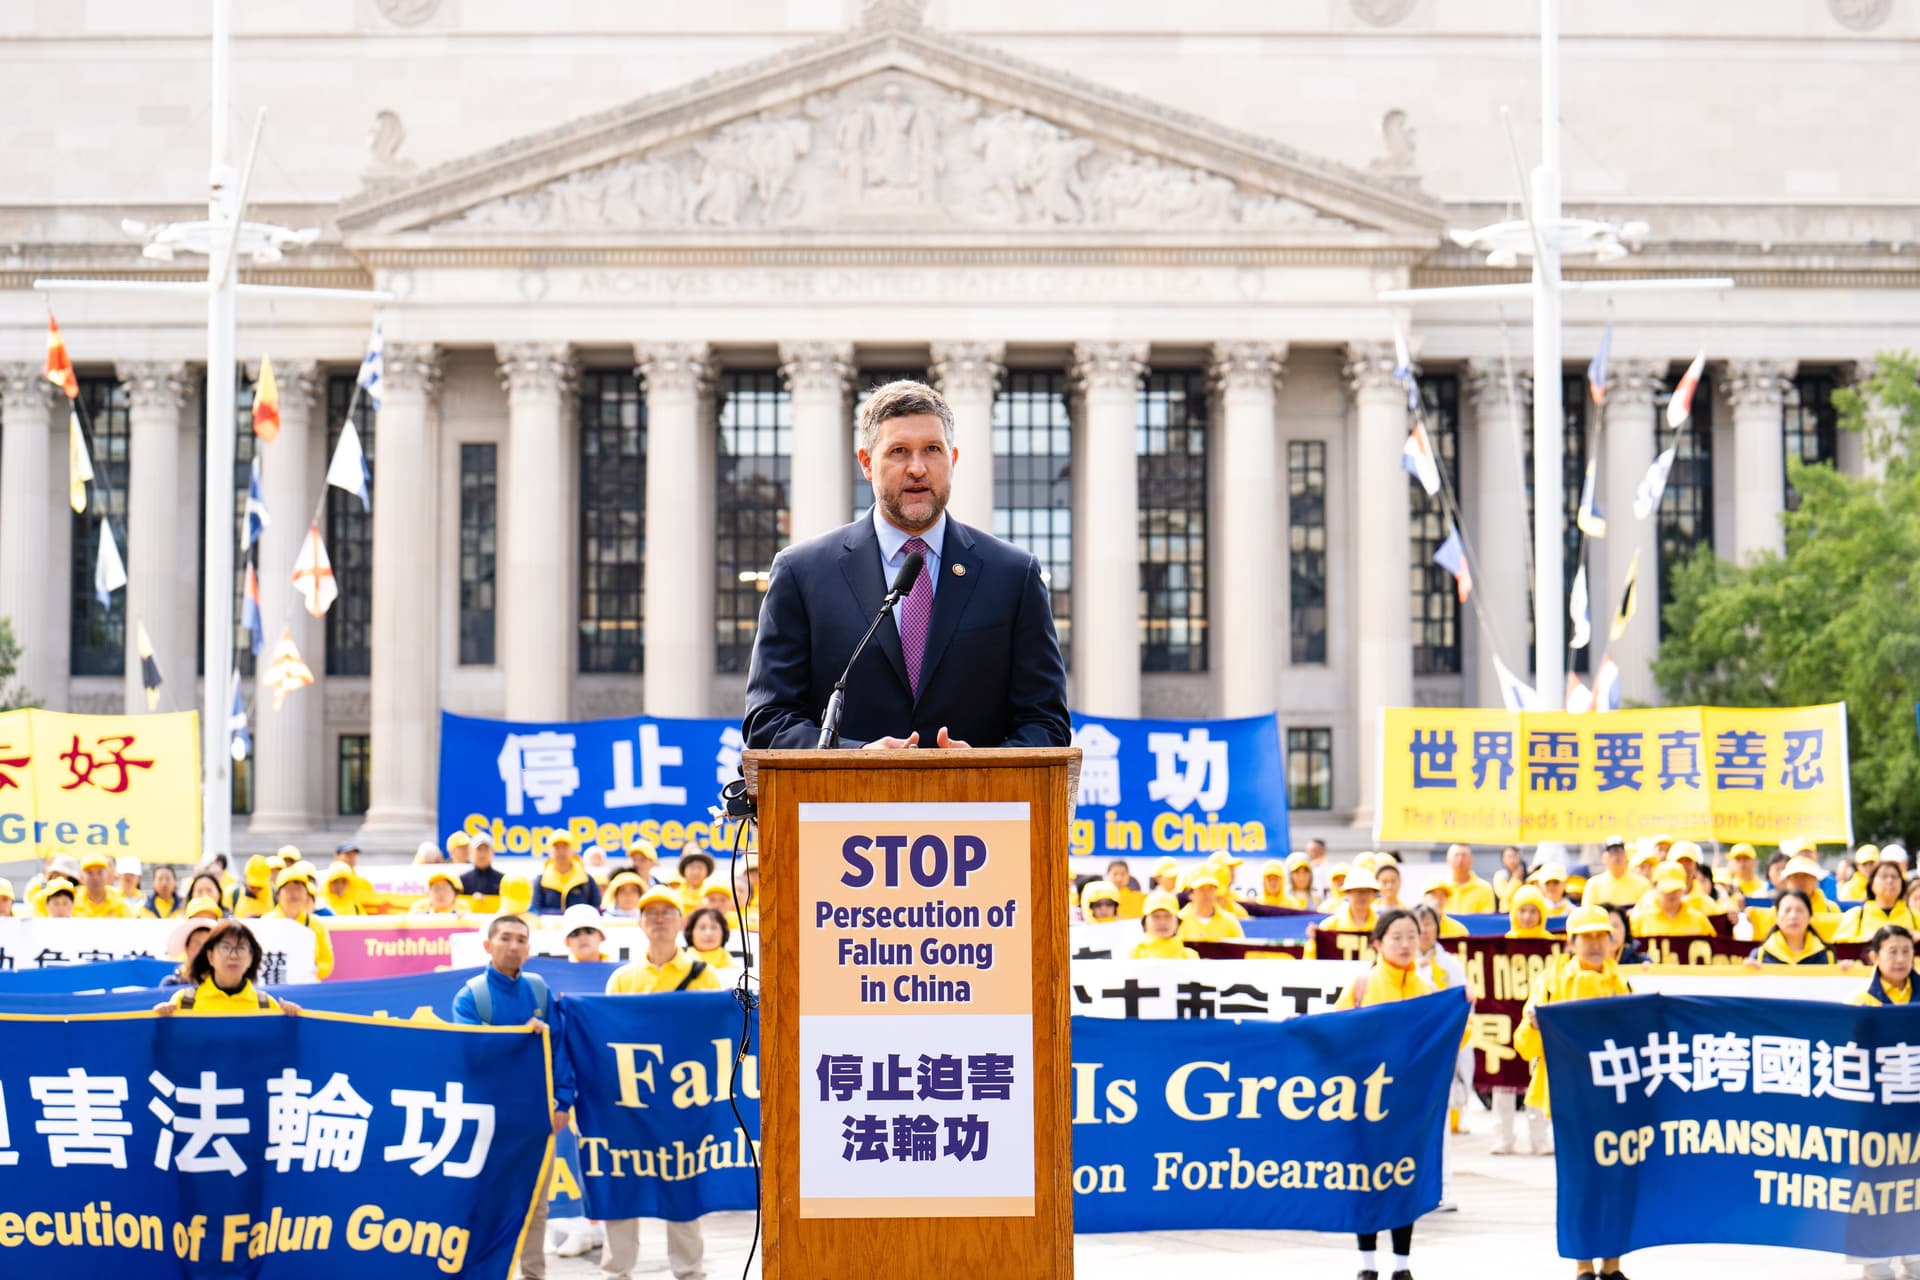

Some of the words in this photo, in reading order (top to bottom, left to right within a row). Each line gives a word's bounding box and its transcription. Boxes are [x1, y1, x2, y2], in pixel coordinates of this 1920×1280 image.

[767, 270, 817, 298] THE
[1409, 729, 1824, 792] 世界需要真善忍
[0, 813, 130, 846] Great
[464, 814, 549, 857] Stop
[1105, 810, 1143, 851] in
[1152, 812, 1267, 852] China
[1403, 807, 1434, 827] The
[1441, 807, 1496, 828] World
[1502, 807, 1558, 829] Needs
[841, 834, 987, 888] STOP
[816, 900, 980, 929] Persecution
[987, 900, 1016, 928] of
[838, 937, 913, 966] Falun
[920, 937, 993, 970] Gong
[861, 974, 886, 1002] in
[893, 974, 971, 1003] China
[816, 1053, 1014, 1101] 停止迫害
[1588, 1031, 1920, 1105] 中共跨國迫害
[1072, 1062, 1138, 1125] Is
[1165, 1061, 1394, 1122] Great
[0, 1067, 496, 1179] 害法輪功
[842, 1114, 989, 1162] 法輪功
[1594, 1125, 1655, 1167] CCP
[1073, 1164, 1127, 1195] on
[1152, 1147, 1416, 1192] Forbearance
[1754, 1169, 1920, 1217] THREATE
[0, 1201, 164, 1252] ecution
[172, 1214, 208, 1262] of
[221, 1206, 333, 1262] Falun
[346, 1204, 470, 1274] Gong
